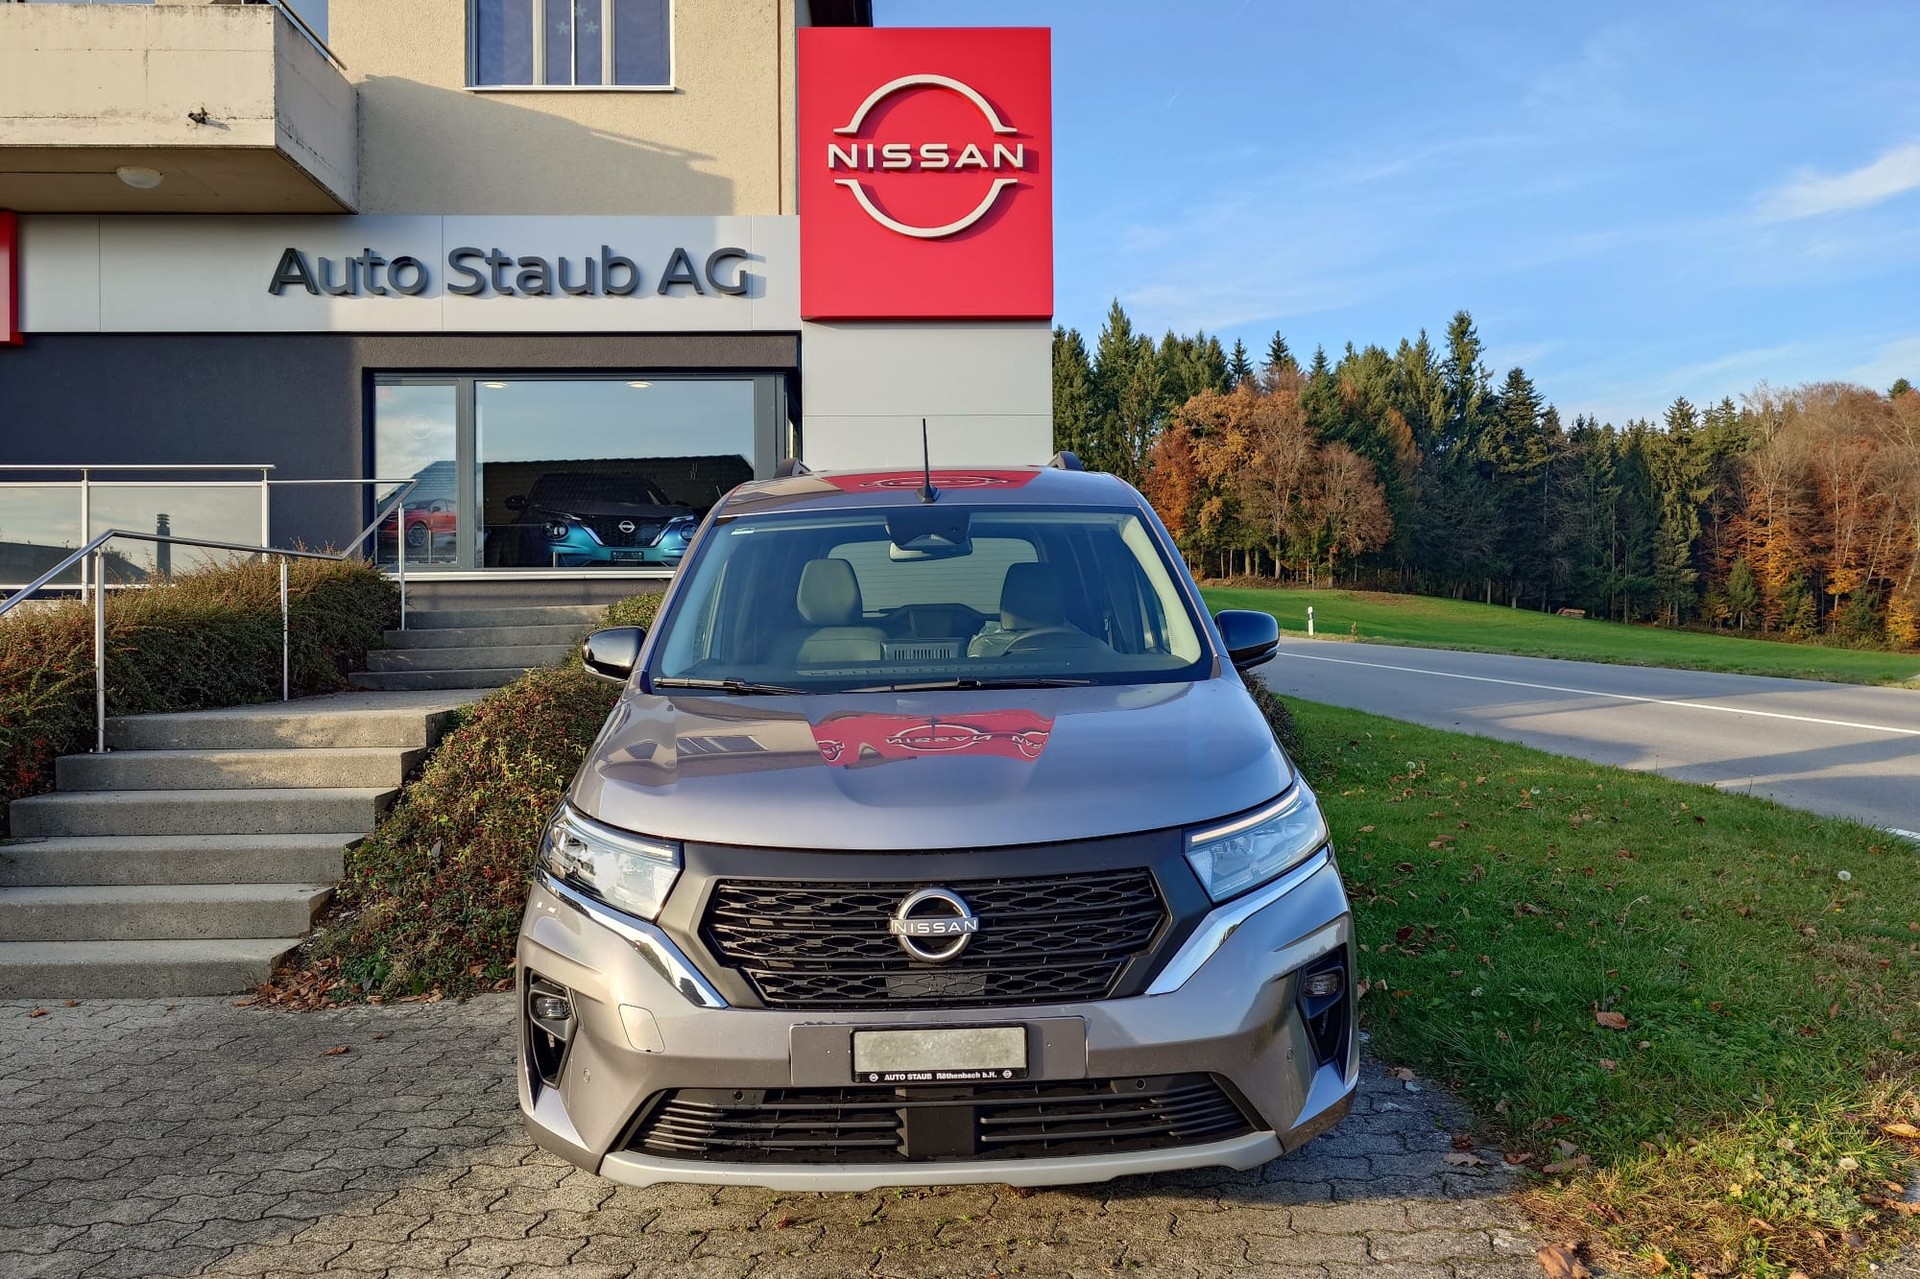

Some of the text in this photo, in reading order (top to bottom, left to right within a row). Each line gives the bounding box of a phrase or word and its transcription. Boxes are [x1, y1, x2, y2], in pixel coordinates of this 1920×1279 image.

[827, 143, 1024, 169] NISSAN
[268, 244, 748, 296] Auto Staub AG
[894, 919, 977, 934] NISSAN
[884, 1073, 906, 1081] AUTO
[906, 1072, 933, 1080] STAUB
[936, 1071, 981, 1080] Röthenbach
